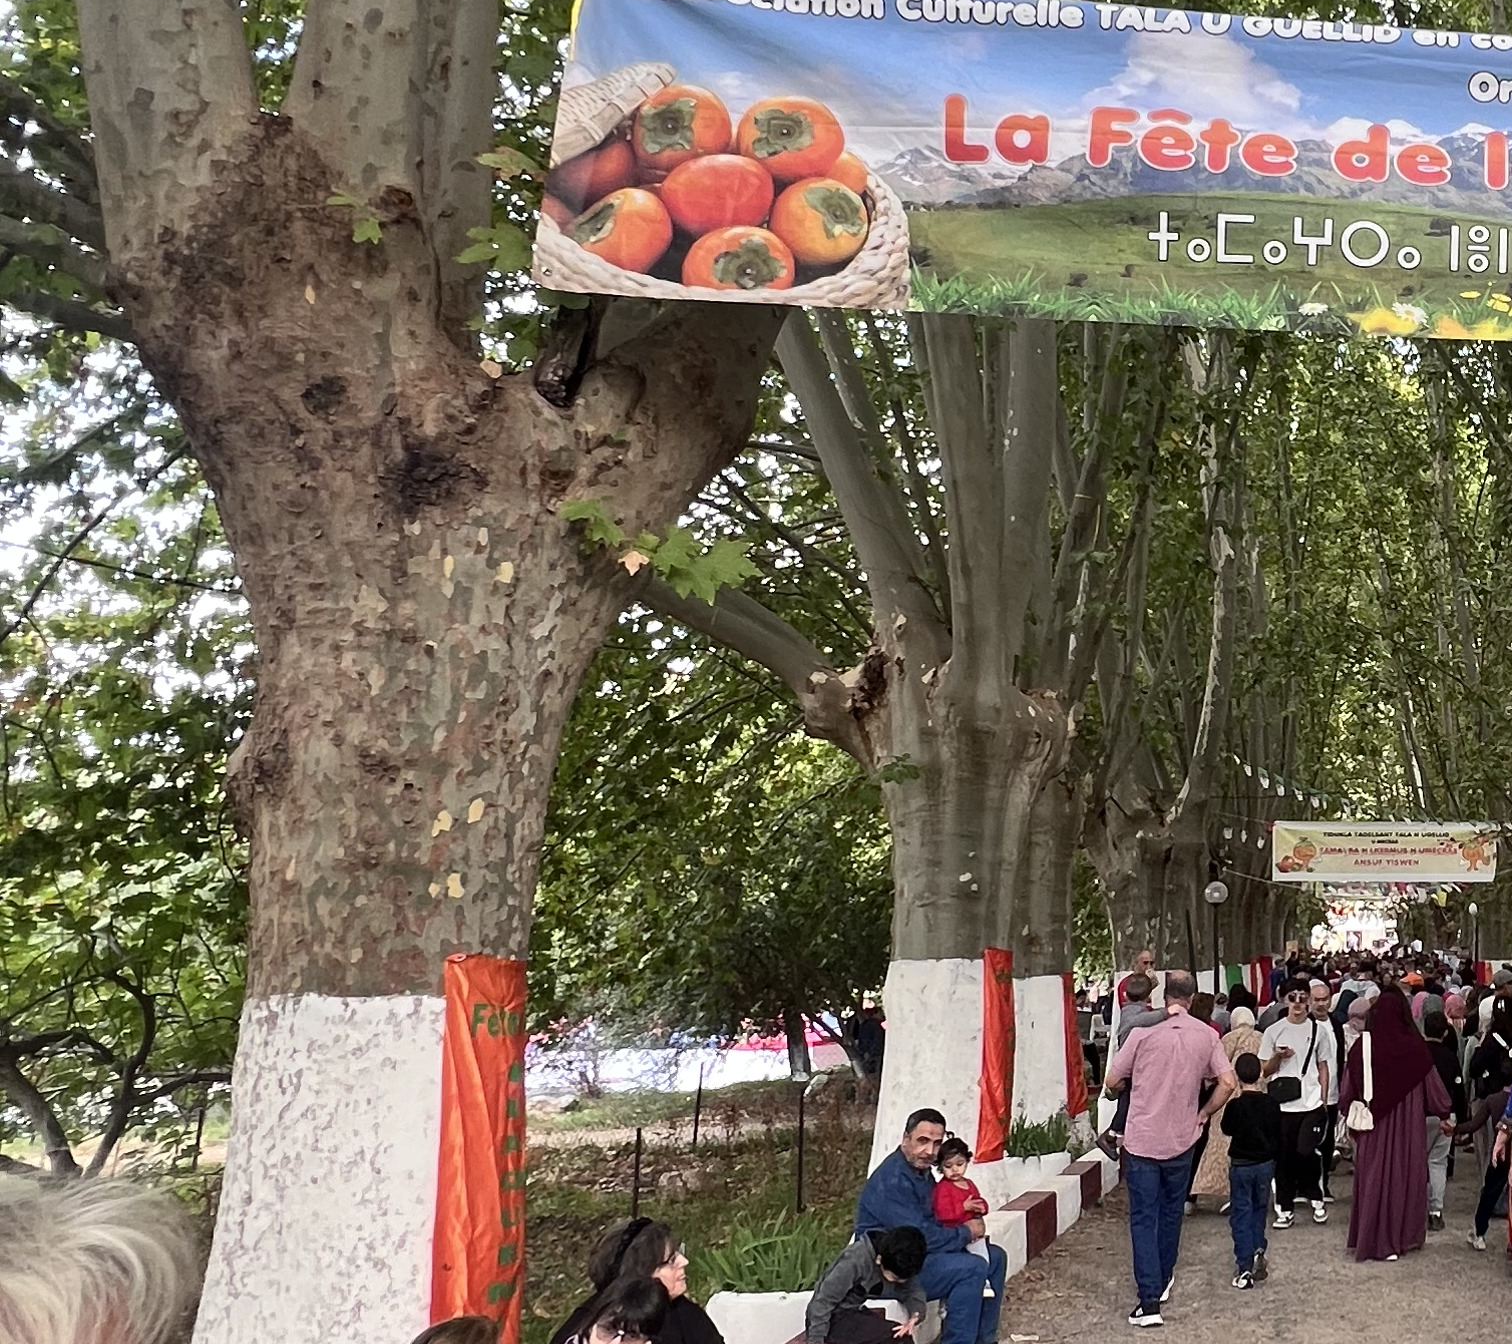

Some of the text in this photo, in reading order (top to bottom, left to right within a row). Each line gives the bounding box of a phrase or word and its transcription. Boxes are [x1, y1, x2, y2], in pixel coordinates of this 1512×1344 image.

[1096, 4, 1192, 34] TALA
[1201, 12, 1233, 36] U
[1242, 14, 1402, 44] GUELLID
[1412, 29, 1460, 48] en
[943, 93, 1052, 166] La
[1086, 106, 1298, 177] Fête
[1331, 124, 1453, 187] de
